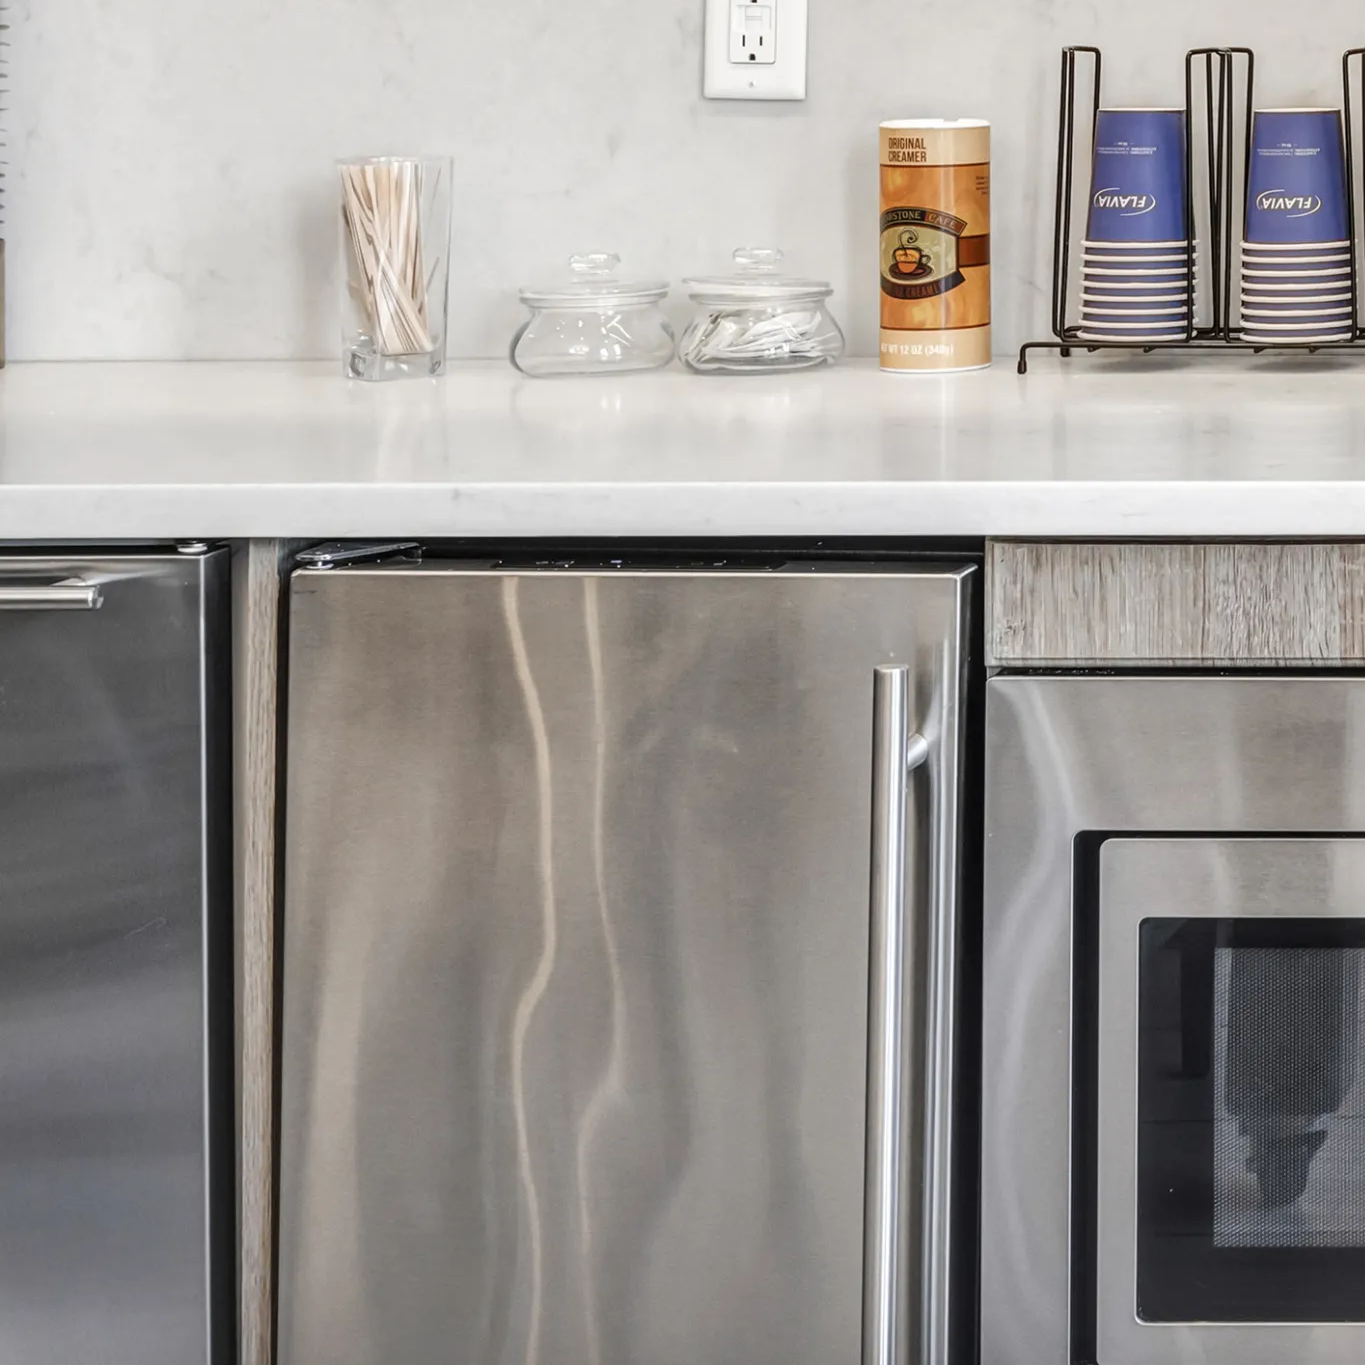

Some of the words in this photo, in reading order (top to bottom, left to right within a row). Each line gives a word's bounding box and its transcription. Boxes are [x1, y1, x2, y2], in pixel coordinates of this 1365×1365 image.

[888, 137, 926, 149] ORIGINAL
[888, 151, 927, 162] CREAMER
[1100, 195, 1146, 209] FLAVIA
[1262, 196, 1311, 210] FLAVIA
[900, 345, 909, 354] 12
[911, 345, 922, 354] OZ
